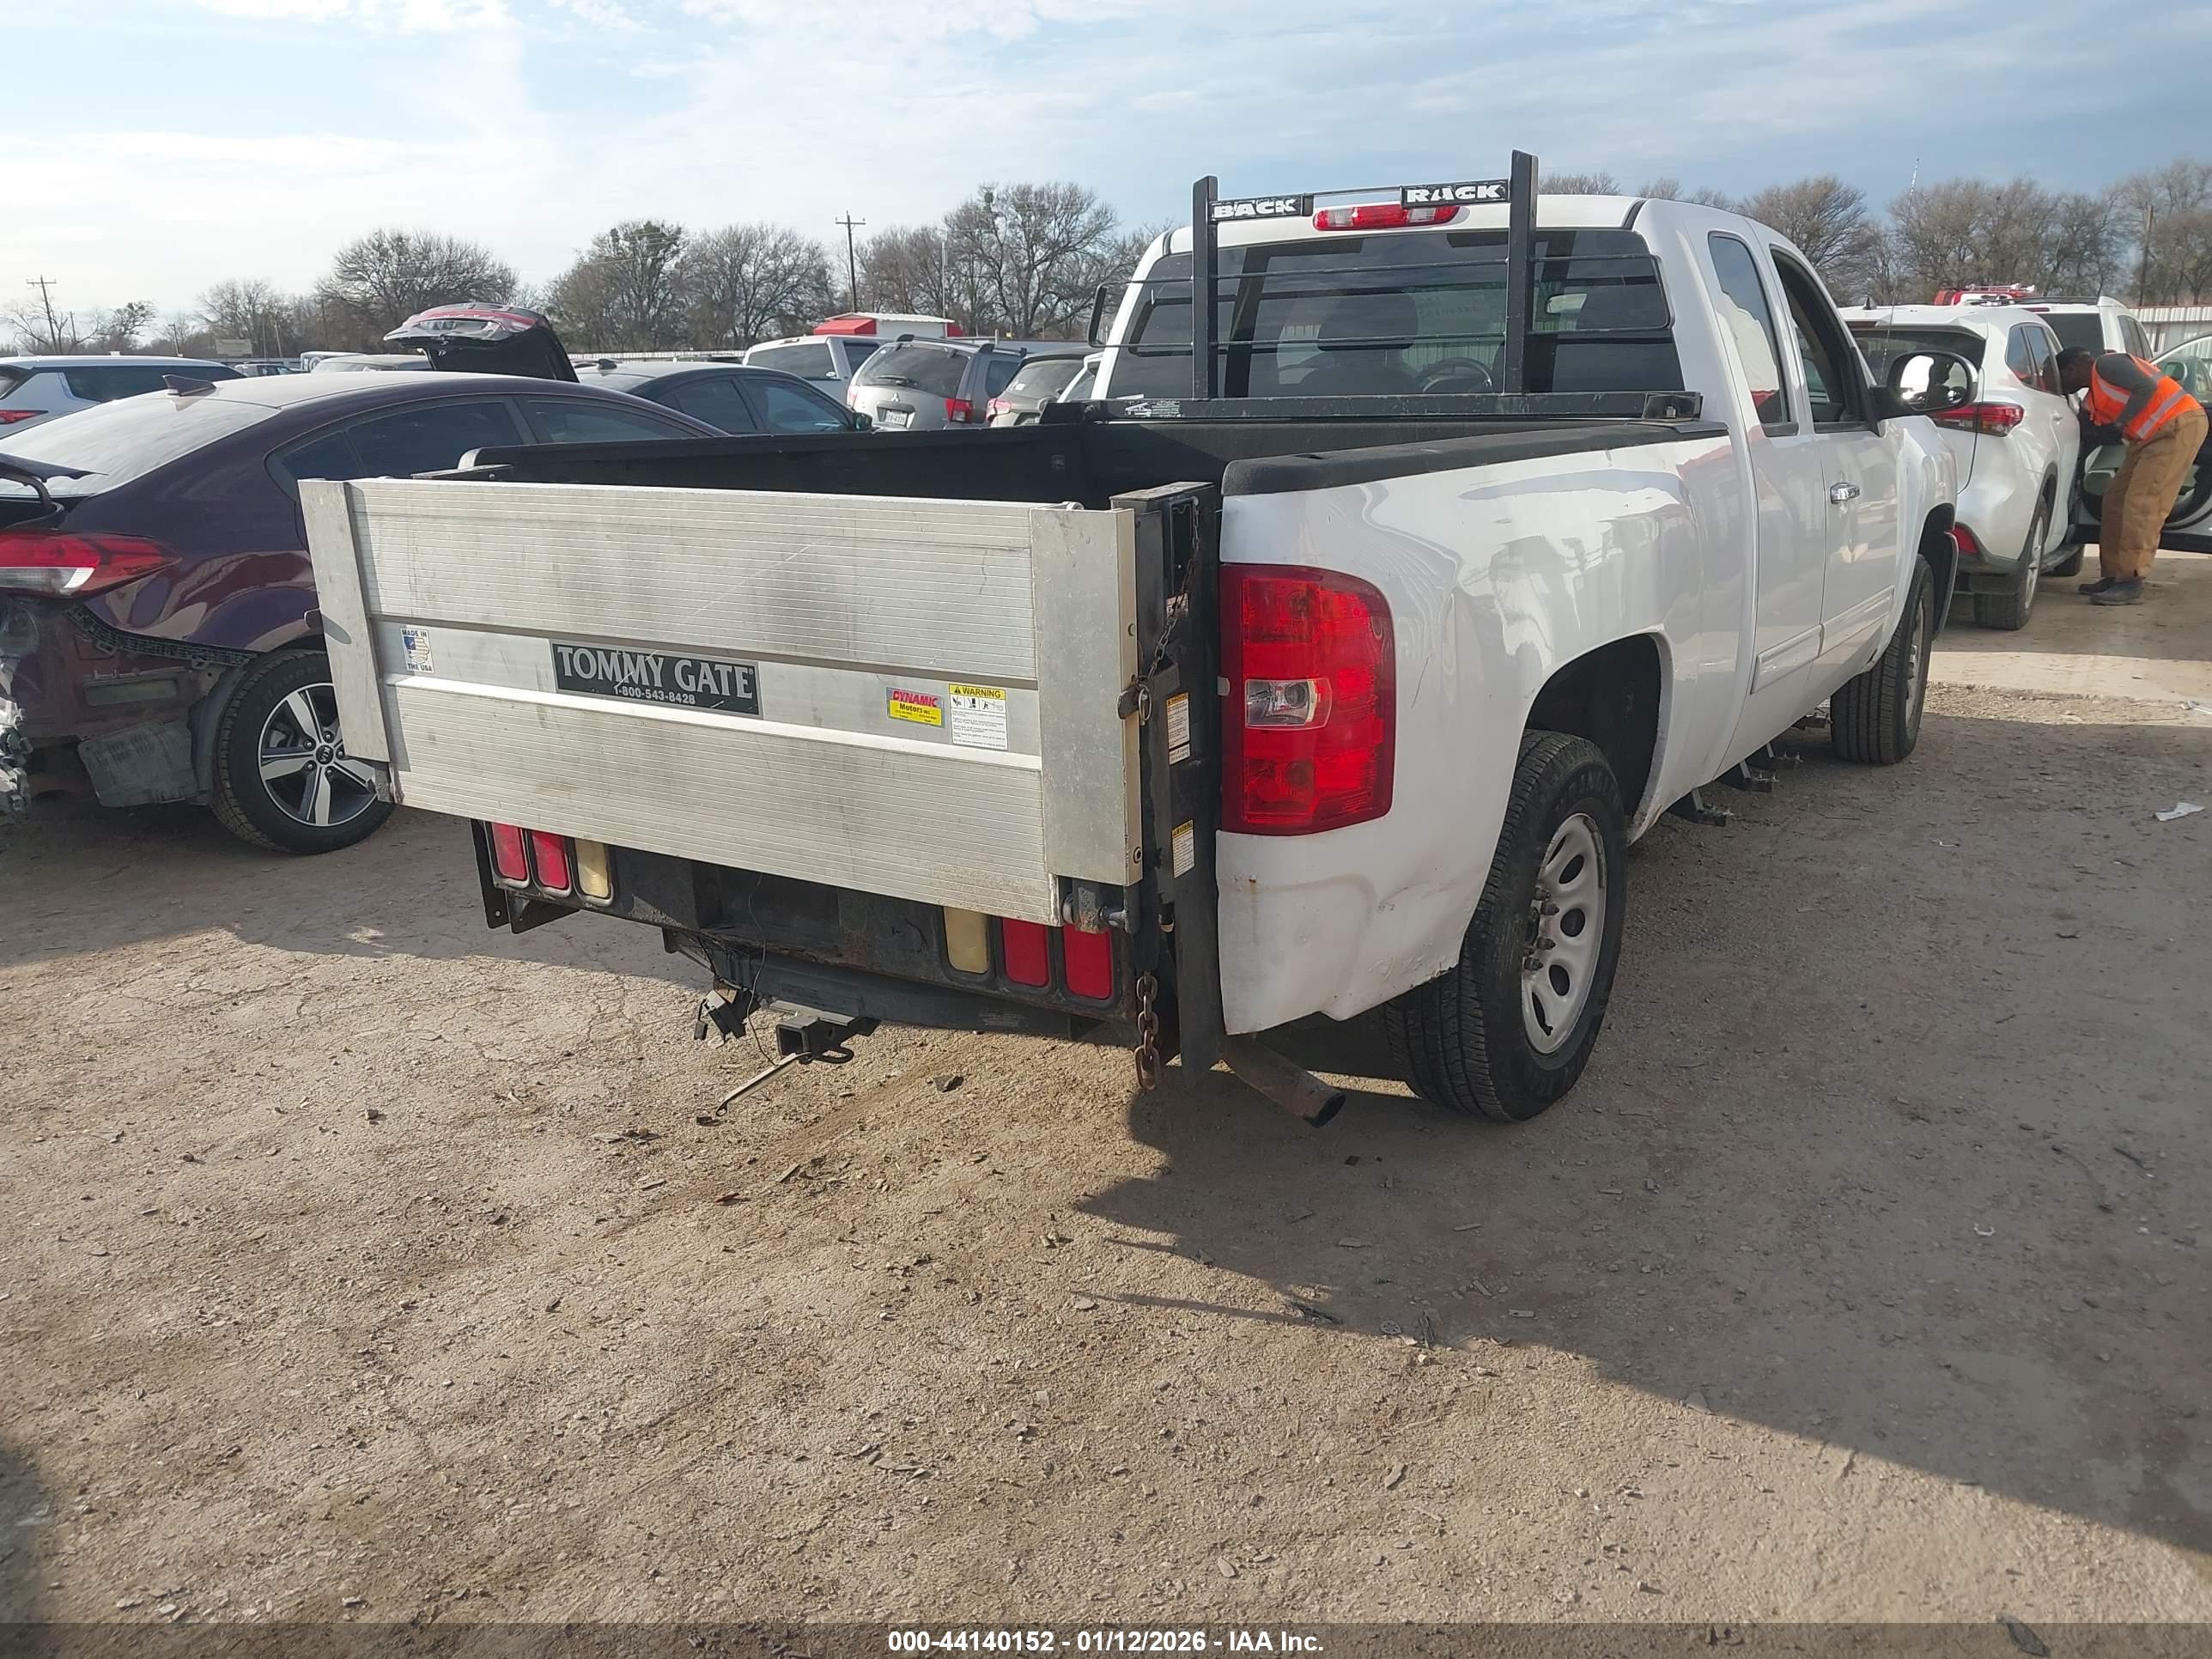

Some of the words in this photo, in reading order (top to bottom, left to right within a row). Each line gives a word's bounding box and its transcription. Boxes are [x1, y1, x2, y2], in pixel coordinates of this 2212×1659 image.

[1212, 198, 1297, 219] BACK
[1407, 184, 1501, 204] RACK
[557, 646, 665, 688] TOMMY
[614, 684, 696, 705] 1-800-543-8428
[893, 690, 939, 708] DYNAMIC
[963, 686, 1001, 698] WARNING
[899, 702, 923, 714] Motors
